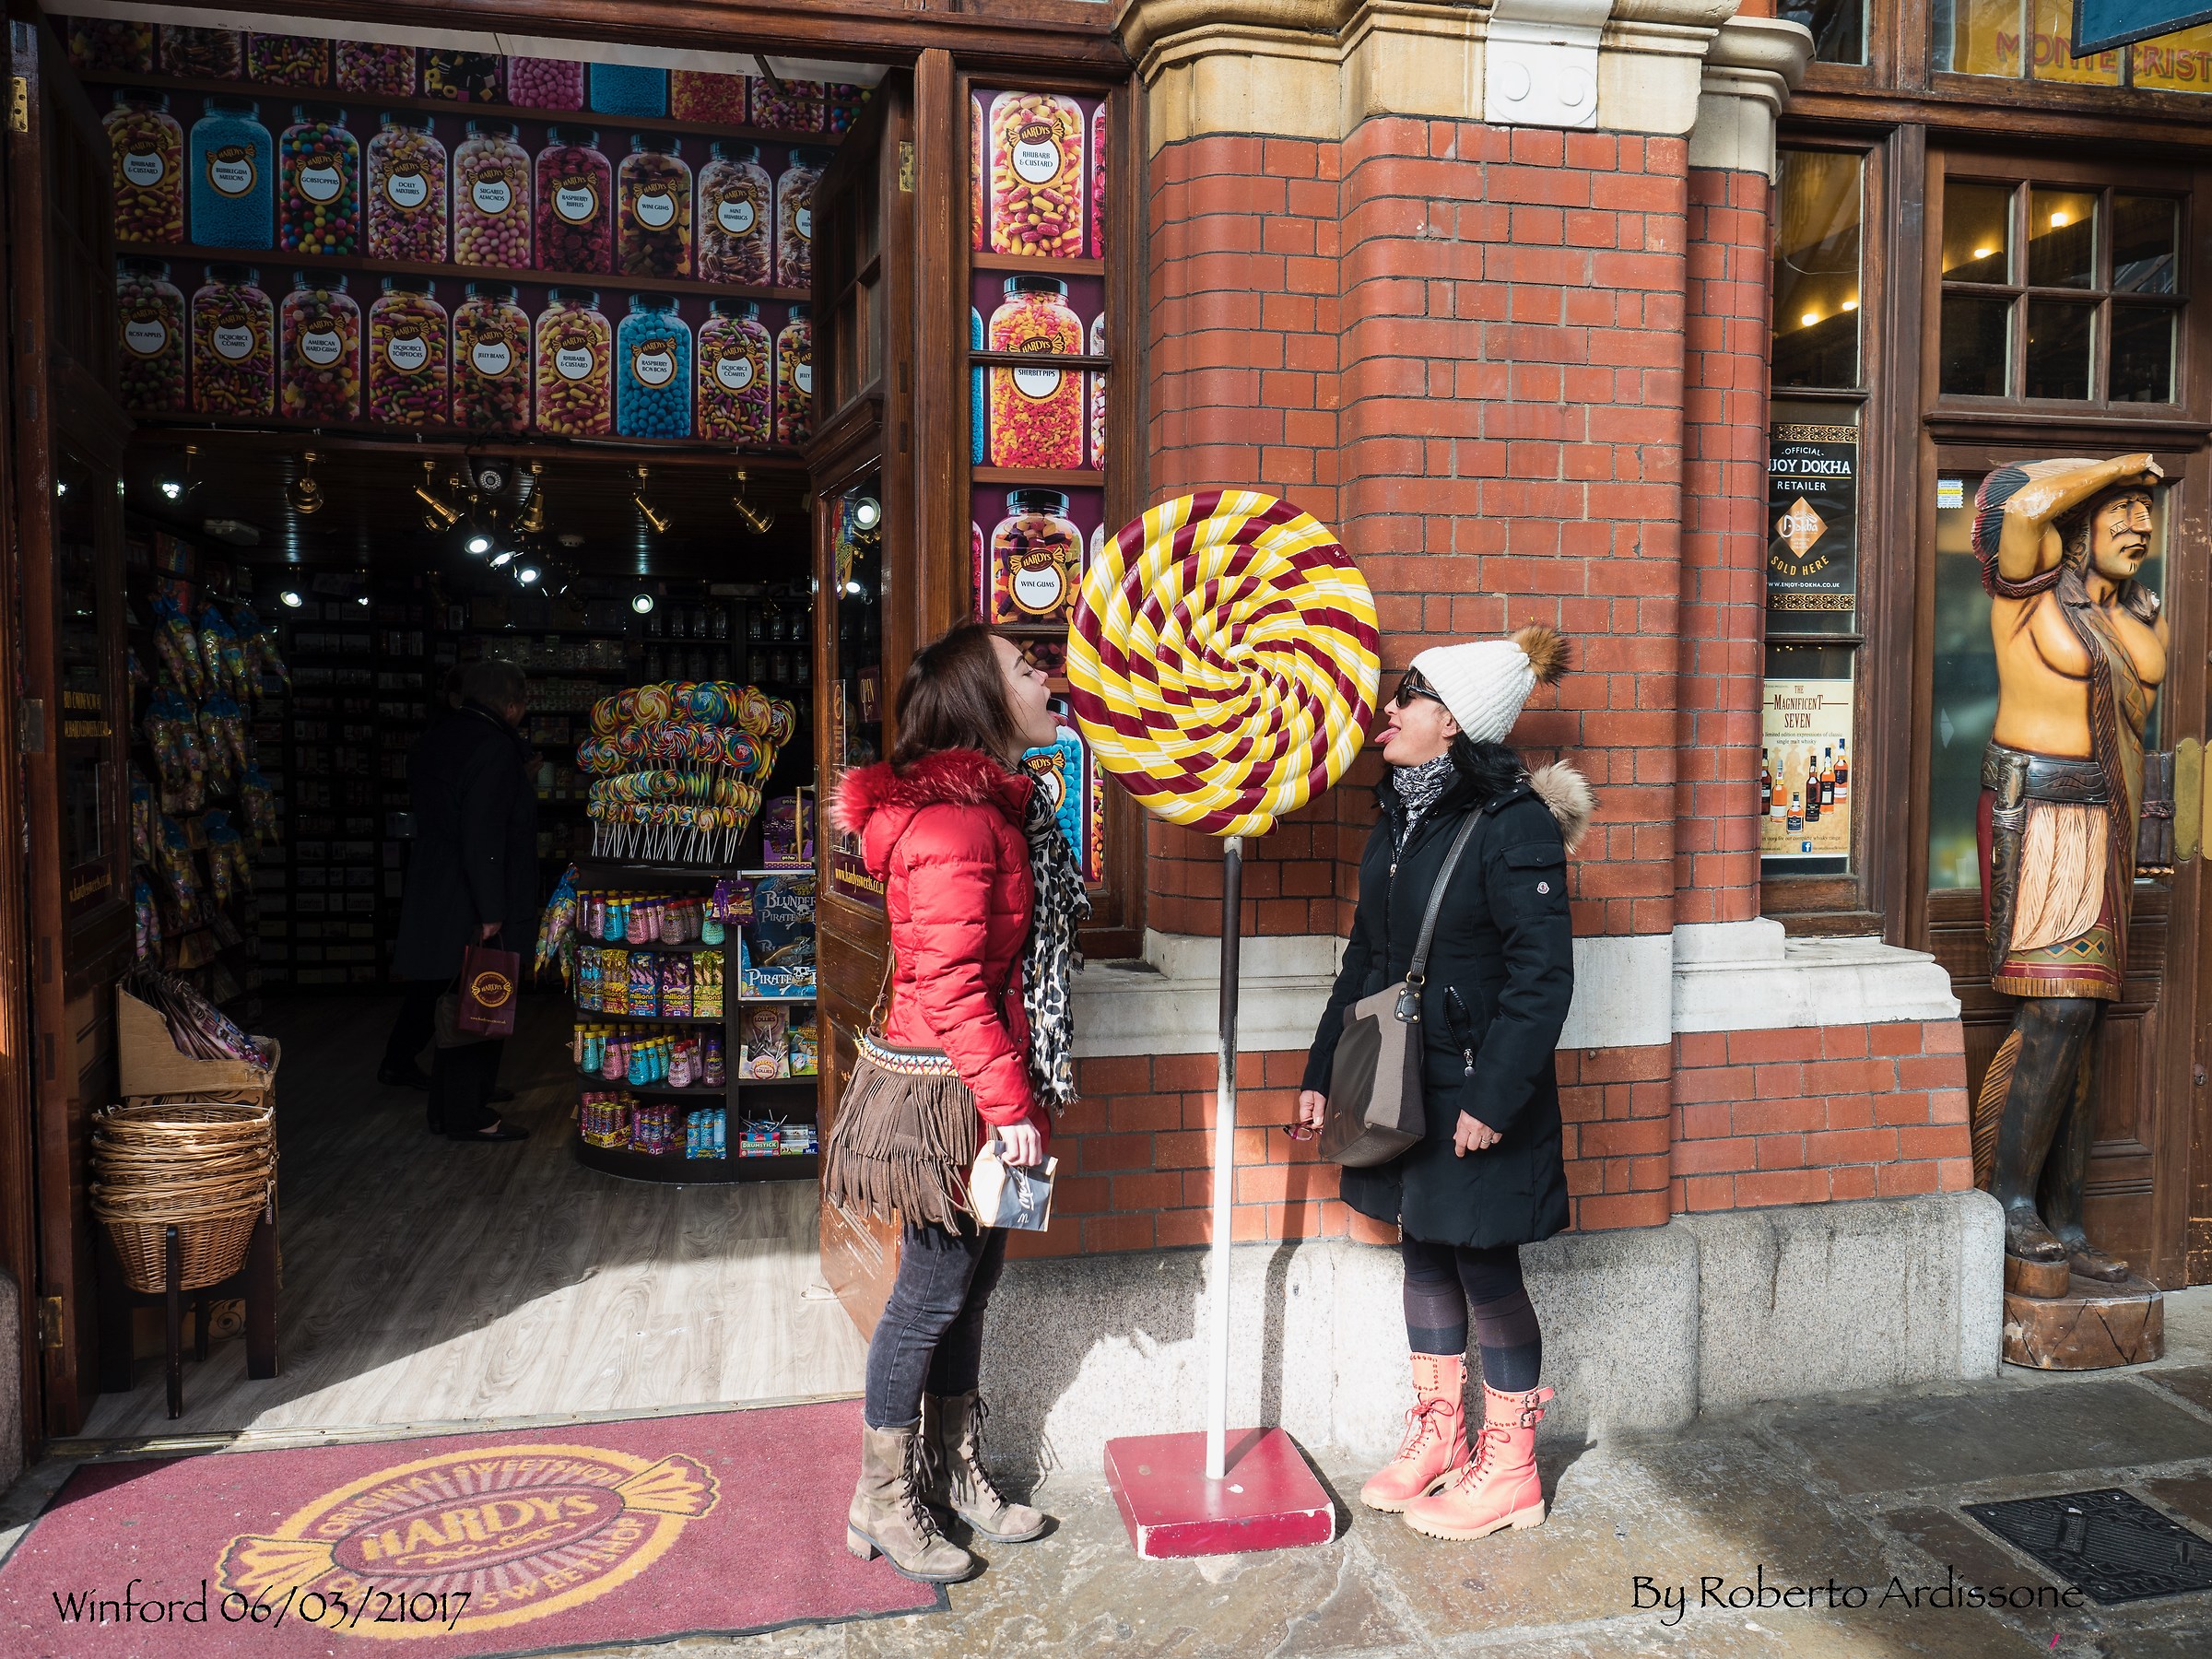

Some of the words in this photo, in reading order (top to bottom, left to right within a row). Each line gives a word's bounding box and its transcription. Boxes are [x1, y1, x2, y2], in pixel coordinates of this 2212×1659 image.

[1996, 31, 2212, 79] MONERIST
[1021, 124, 1051, 140] HARDYS
[129, 140, 157, 154] HARDYS
[218, 148, 244, 159] HARDYS
[1022, 150, 1051, 159] RHUBARB
[130, 160, 156, 169] RHUBARB
[306, 156, 332, 168] HARDYS
[1025, 159, 1053, 168] CUSTARD
[394, 163, 419, 174] HARDYS
[478, 168, 505, 181] HARDYS
[301, 176, 339, 185] GOBSTOPPERS
[562, 175, 587, 188] HARDYS
[643, 182, 668, 194] HARDYS
[724, 189, 747, 201] HARDYS
[132, 308, 159, 320] HARDYS
[219, 313, 246, 327] HARDYS
[308, 318, 335, 331] HARDYS
[394, 324, 419, 337] HARDYS
[479, 330, 505, 343] HARDYS
[561, 335, 587, 347] HARDYS
[642, 341, 667, 353] HARDYS
[722, 346, 747, 358] HARDYS
[1021, 340, 1051, 354] HARDYS
[1018, 369, 1040, 377] SHERBET
[1041, 370, 1055, 378] PIPS
[1801, 461, 1852, 475] DOKHA
[1777, 481, 1827, 491] RETAILER
[1022, 552, 1052, 568] HARDYS
[1771, 556, 1796, 576] SOLD
[1802, 555, 1830, 576] HERE
[1768, 582, 1840, 592] WW.ENJOY-DOKHA.CO.UK
[1773, 694, 1823, 711] MAGNIFICENT
[1784, 712, 1811, 728] SEVEN
[1028, 758, 1051, 771] RDYS
[759, 909, 796, 922] PIRATE
[745, 968, 793, 987] PIRATE
[629, 992, 655, 1001] millions
[664, 993, 690, 1001] millions
[695, 993, 722, 1001] millions
[362, 1493, 601, 1561] HARDYS
